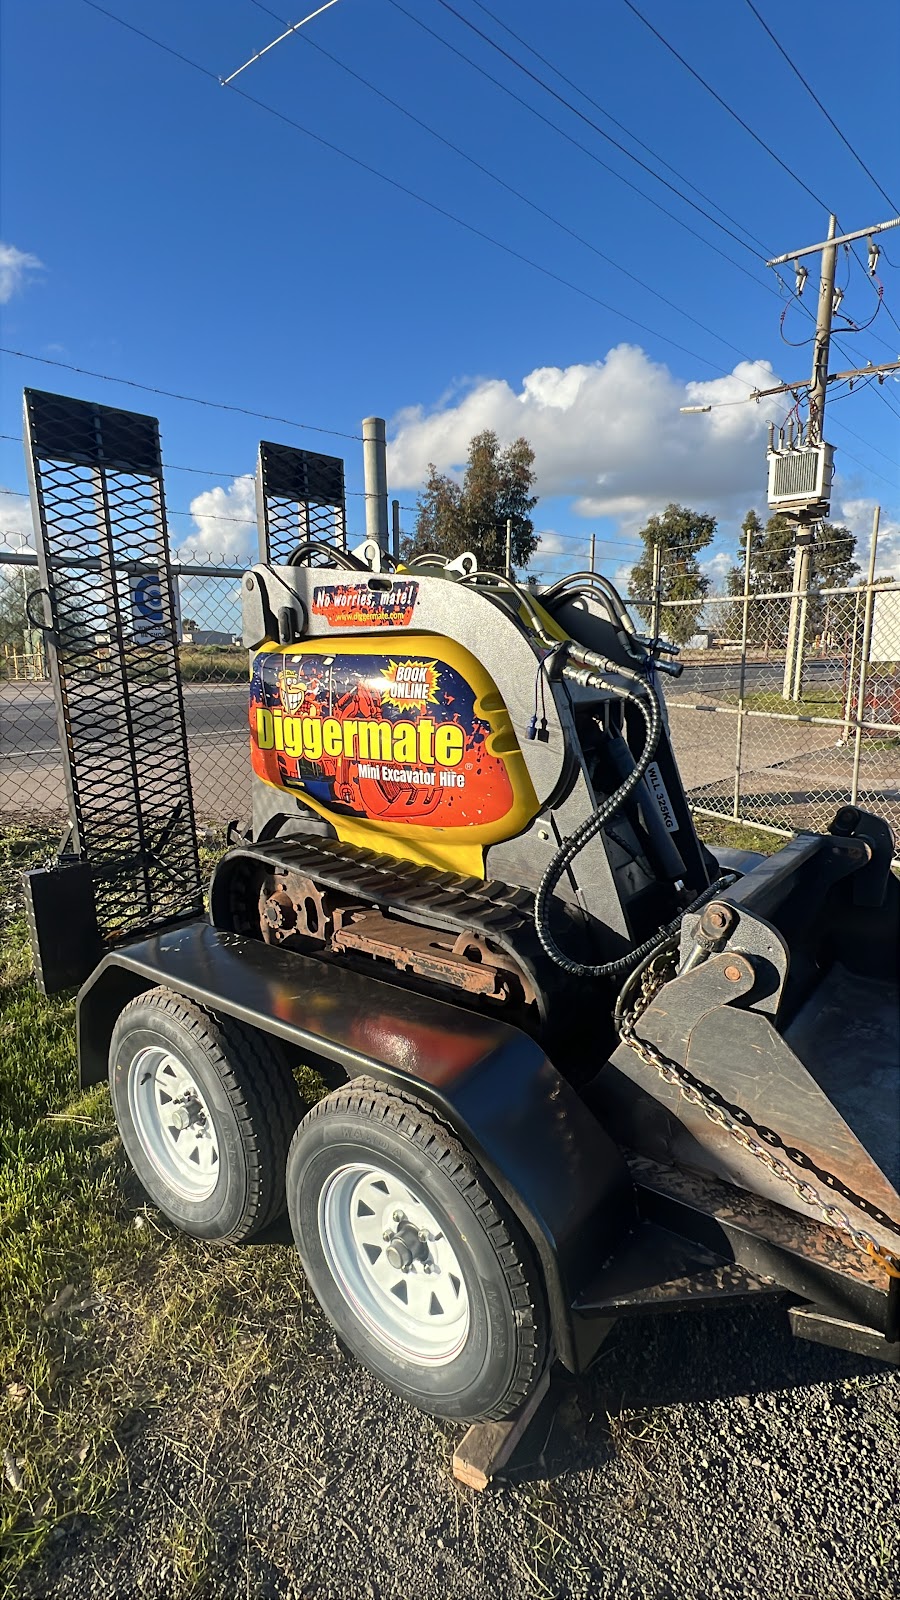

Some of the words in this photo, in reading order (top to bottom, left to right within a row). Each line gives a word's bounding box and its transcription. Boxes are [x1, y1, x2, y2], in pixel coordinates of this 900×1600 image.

[317, 591, 331, 607] No
[333, 592, 377, 607] worries,
[380, 586, 413, 606] mate!
[336, 611, 404, 622] www.diggermate.com
[395, 666, 428, 682] BOOK
[389, 682, 430, 699] ONLINE
[255, 707, 464, 767] Diggermate
[358, 764, 381, 780] Mini
[382, 766, 437, 786] Excavator
[440, 771, 465, 788] Hire
[648, 767, 661, 791] WLL
[656, 793, 674, 828] 325KG
